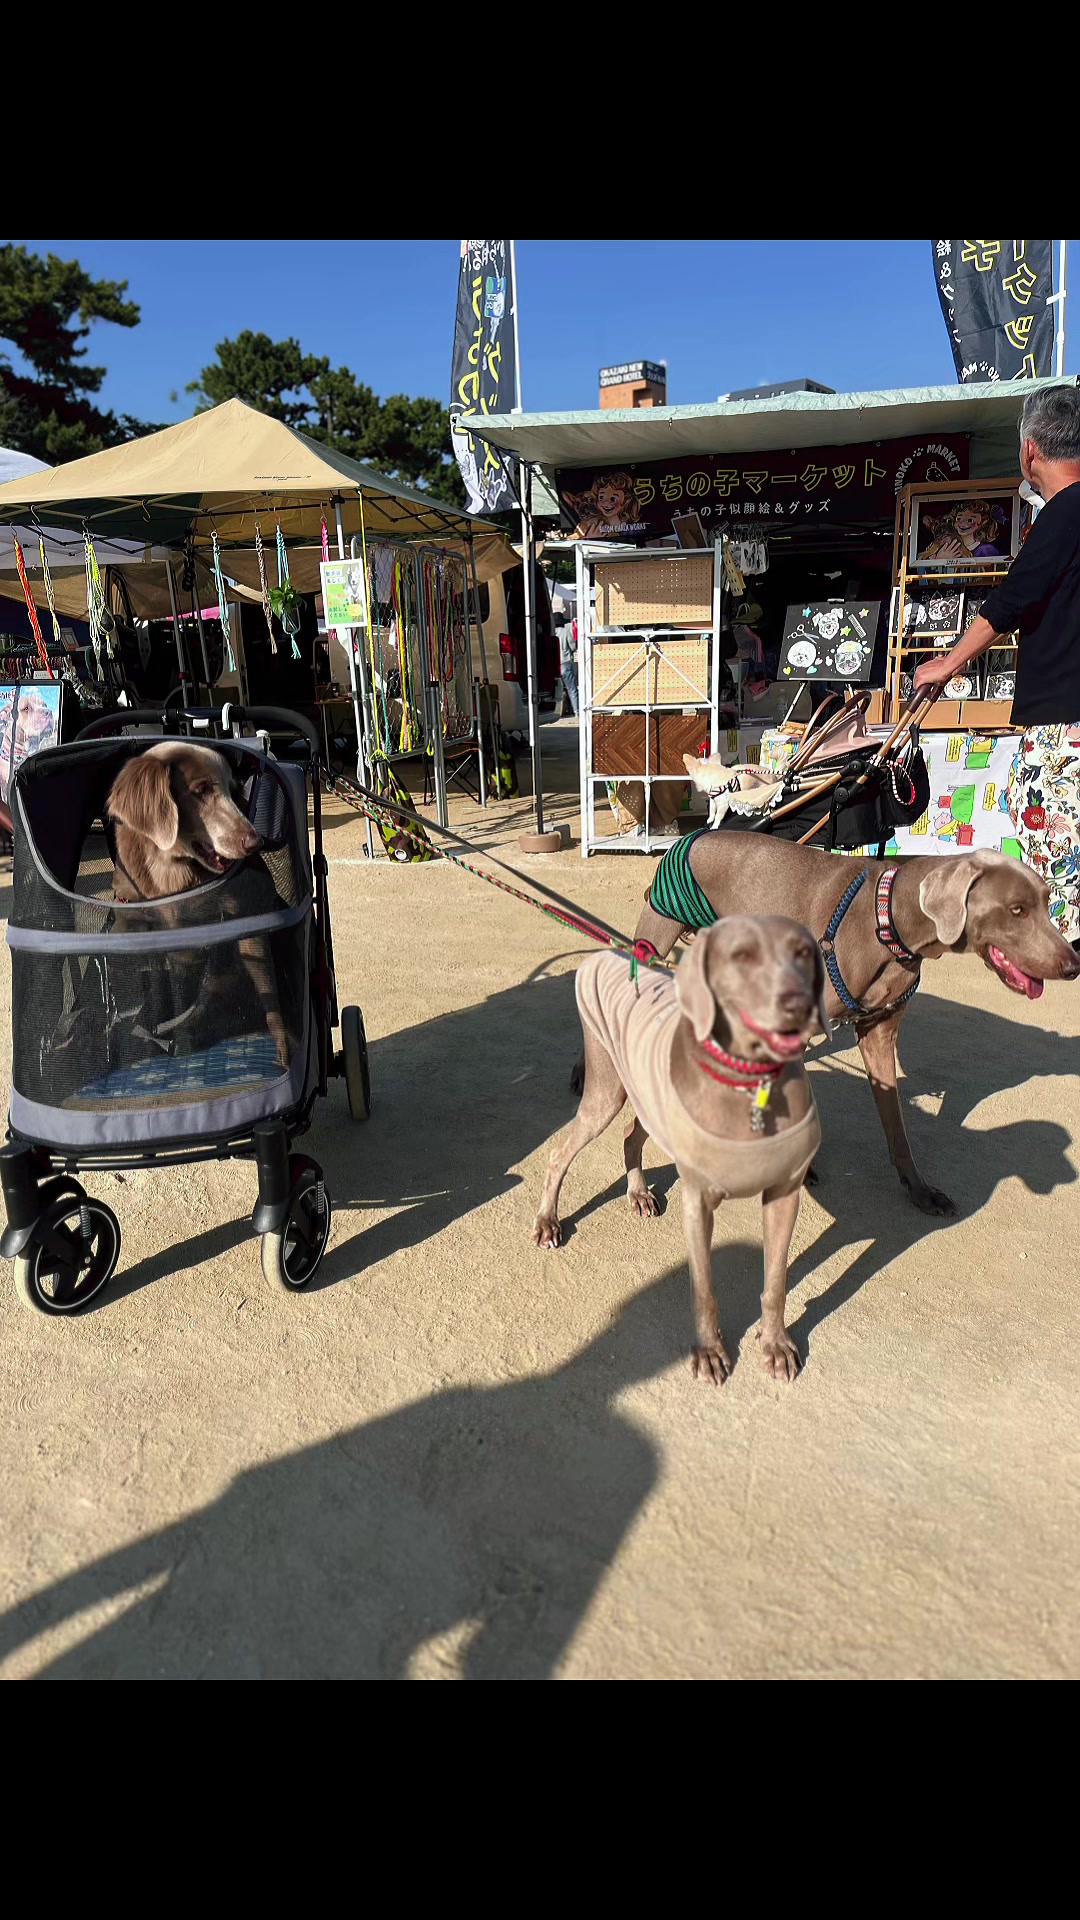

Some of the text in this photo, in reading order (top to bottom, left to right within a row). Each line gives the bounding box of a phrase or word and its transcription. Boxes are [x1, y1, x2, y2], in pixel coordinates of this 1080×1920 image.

[623, 371, 643, 383] HOTEL
[628, 362, 643, 372] NEW
[926, 443, 961, 472] MARKET
[633, 458, 887, 506] うちの子マーケット
